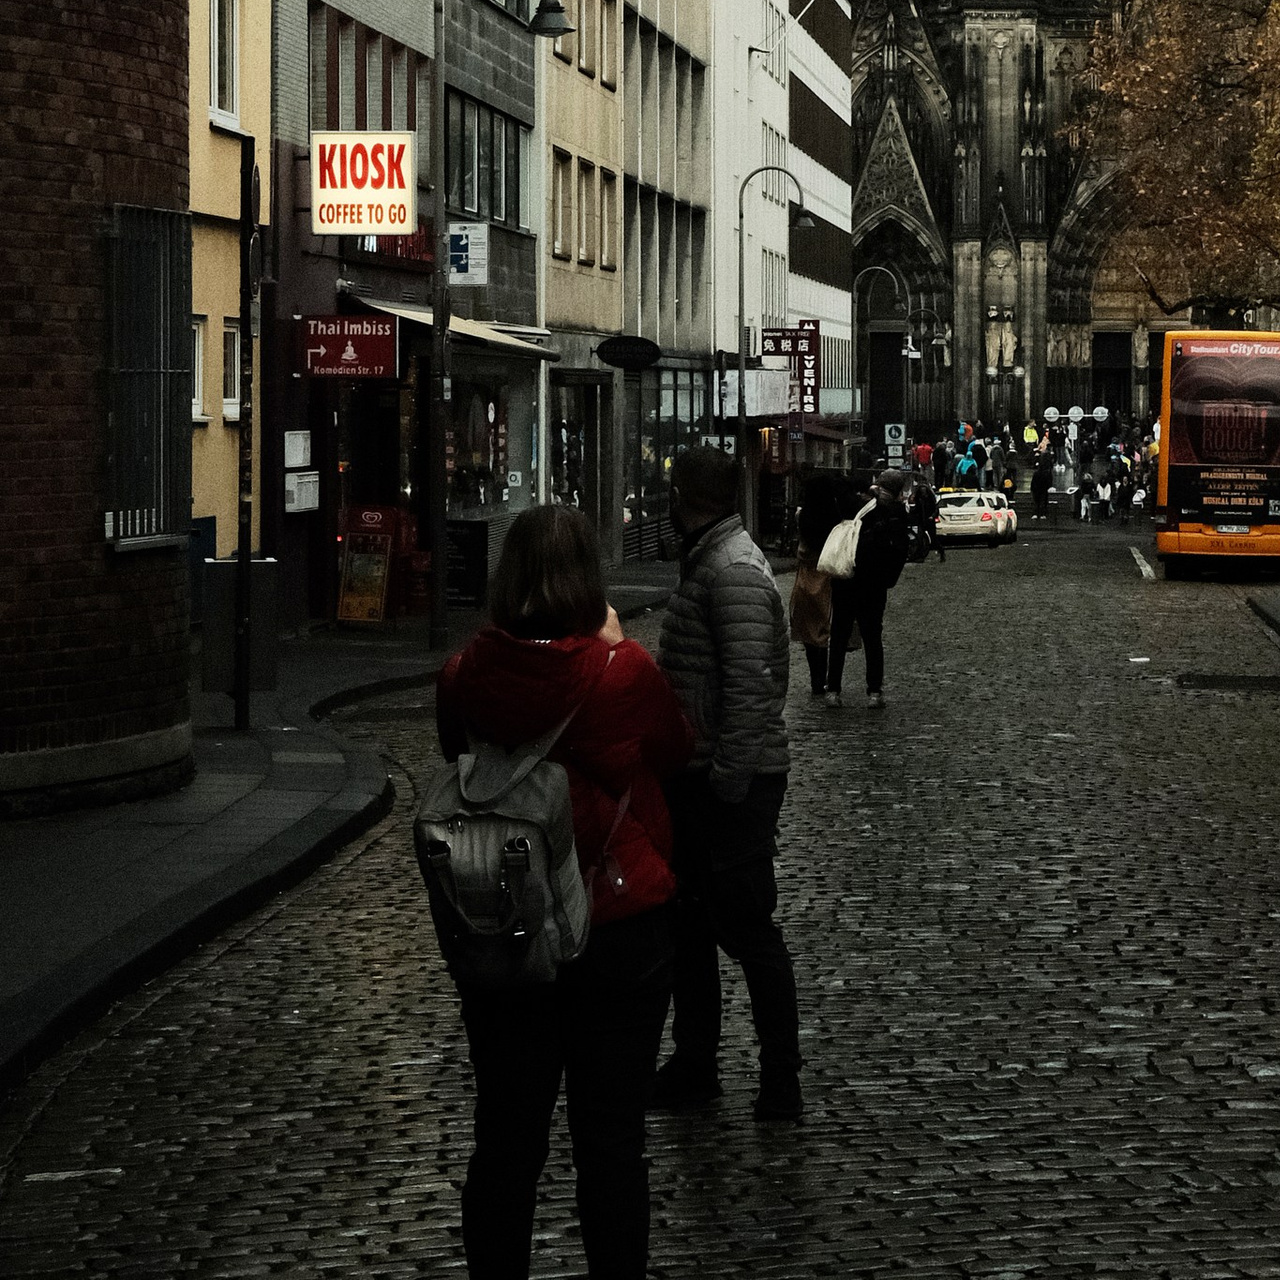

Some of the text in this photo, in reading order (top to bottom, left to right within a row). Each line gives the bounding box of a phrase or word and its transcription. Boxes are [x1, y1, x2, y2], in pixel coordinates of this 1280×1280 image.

[318, 143, 406, 190] KIOSK
[318, 203, 407, 225] COFFEE TO GO
[308, 320, 391, 336] Thai Imbiss
[763, 338, 810, 352] 免税店
[357, 366, 372, 374] Str.
[374, 366, 384, 374] 17
